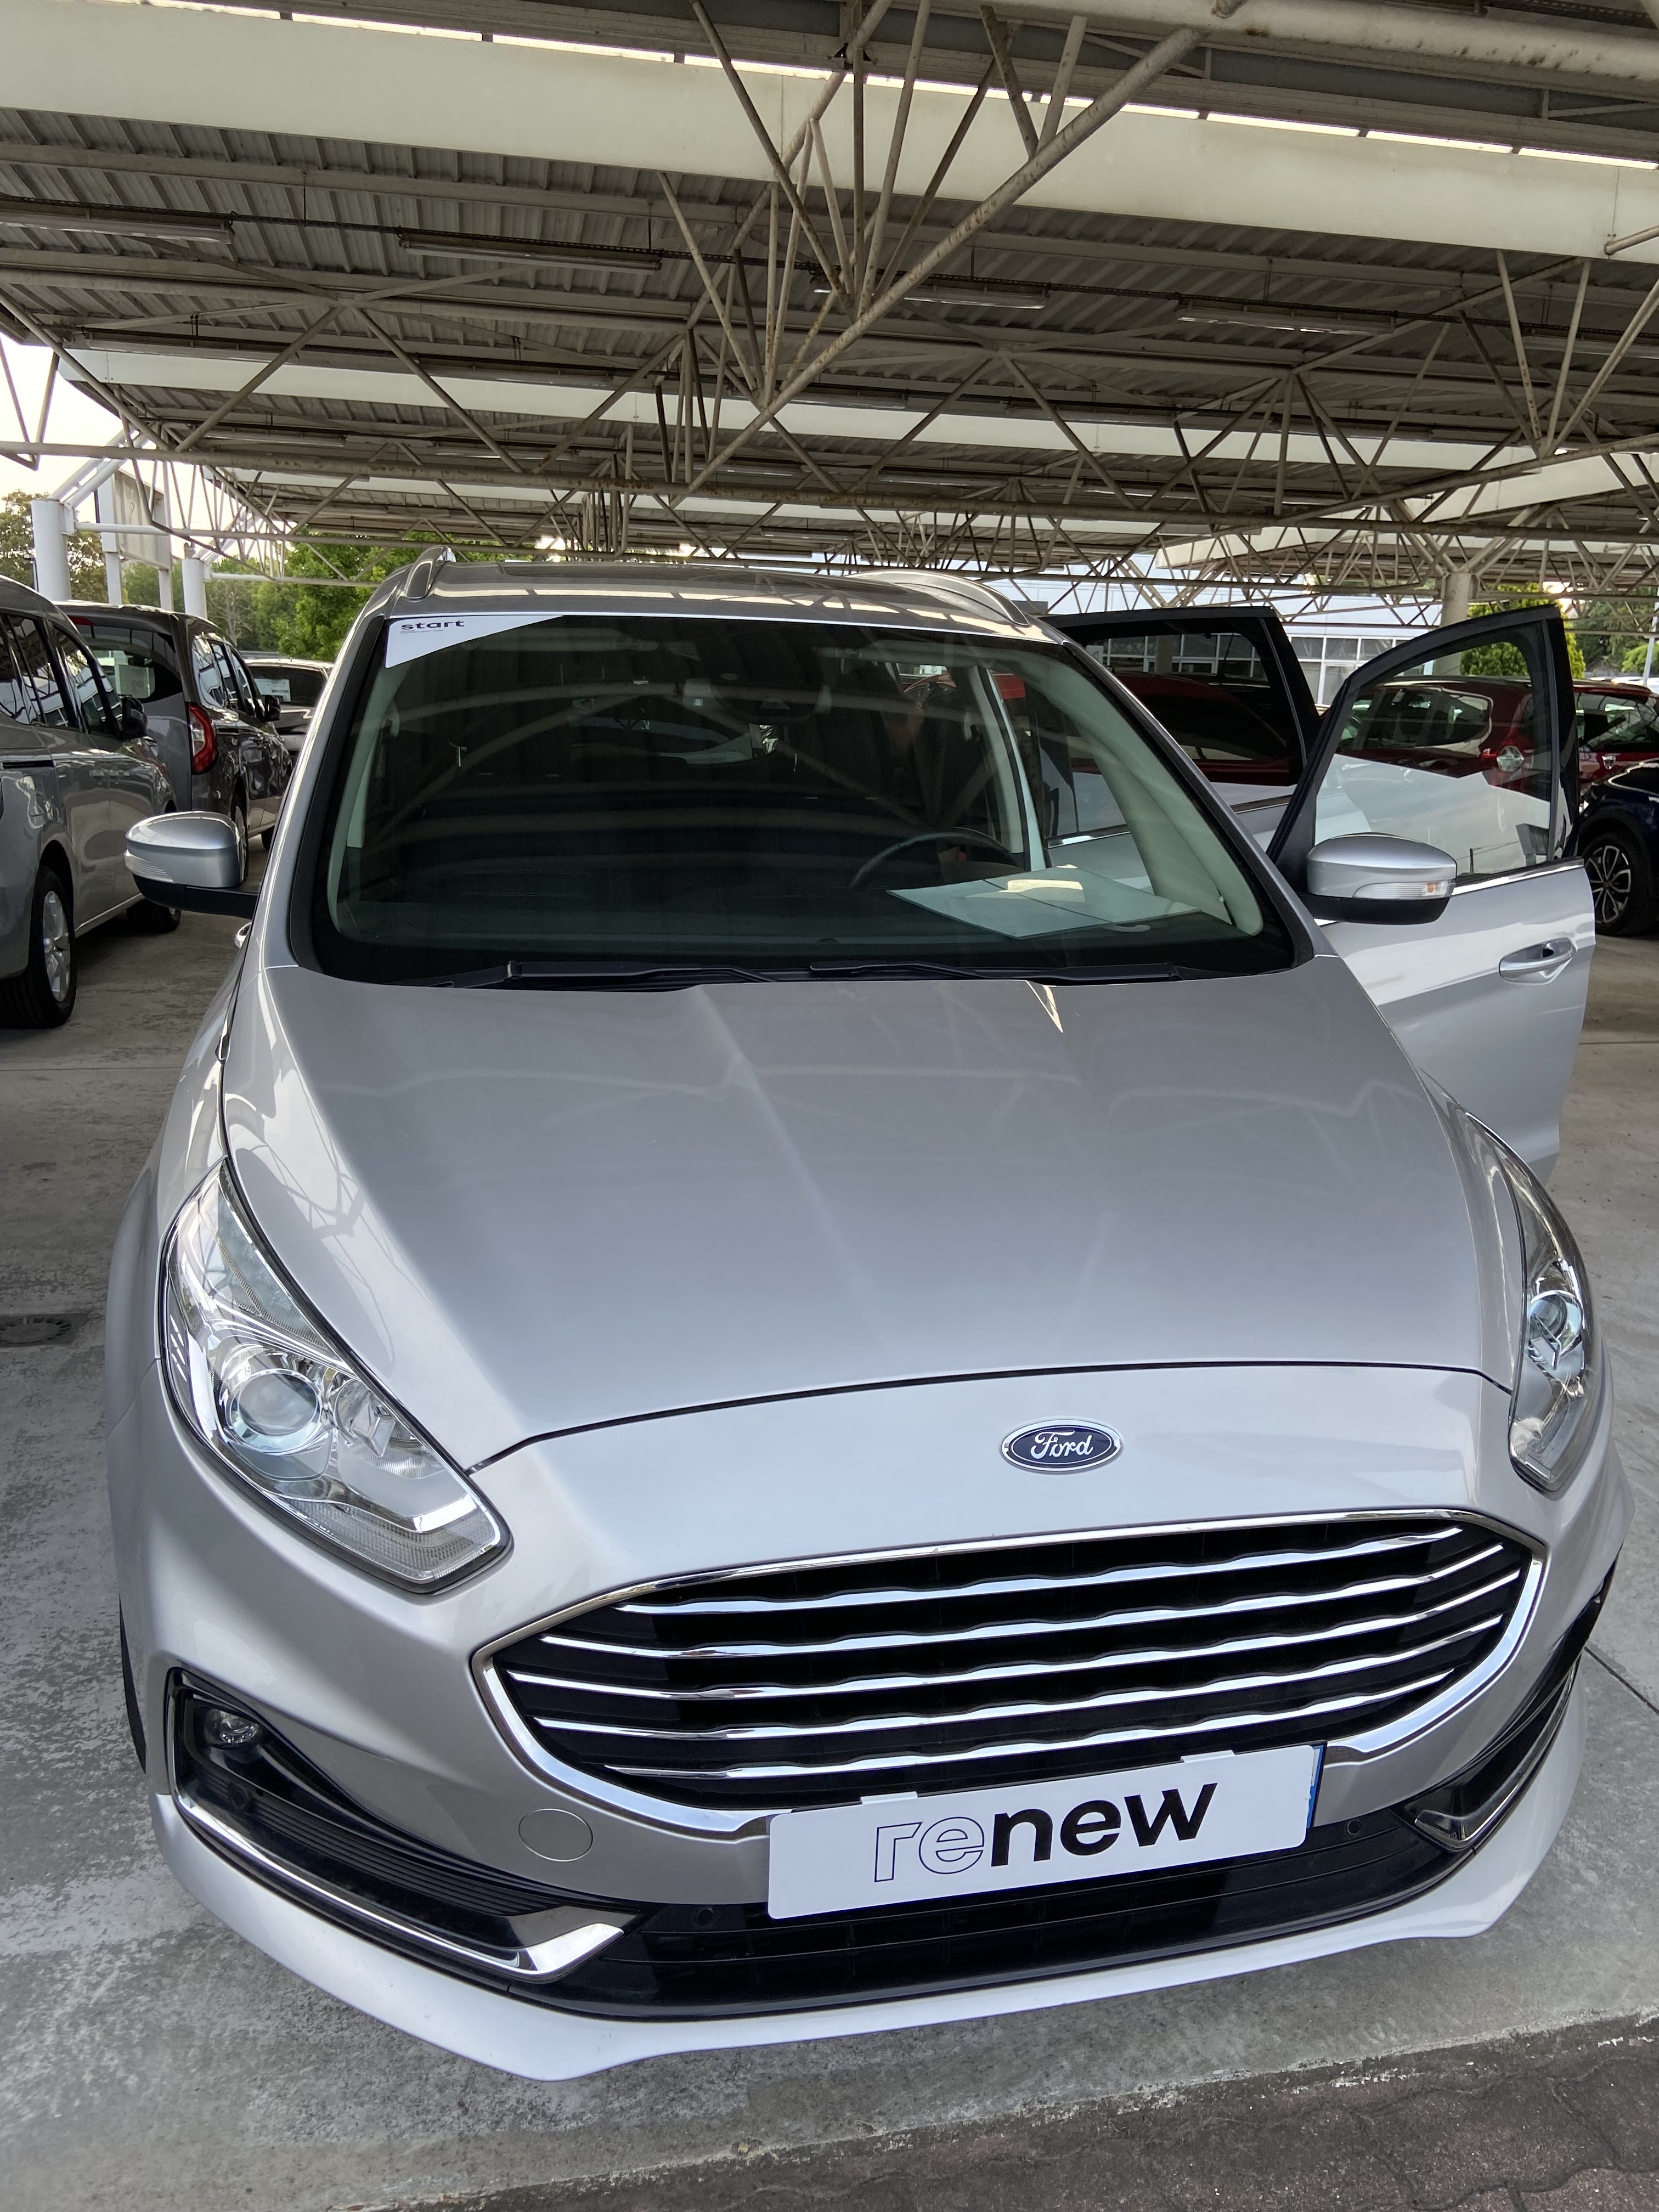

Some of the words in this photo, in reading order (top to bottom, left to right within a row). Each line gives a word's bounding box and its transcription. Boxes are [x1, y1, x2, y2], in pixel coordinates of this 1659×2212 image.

[401, 620, 465, 630] start
[1030, 1430, 1094, 1459] Ford
[874, 1782, 1218, 1882] renew
